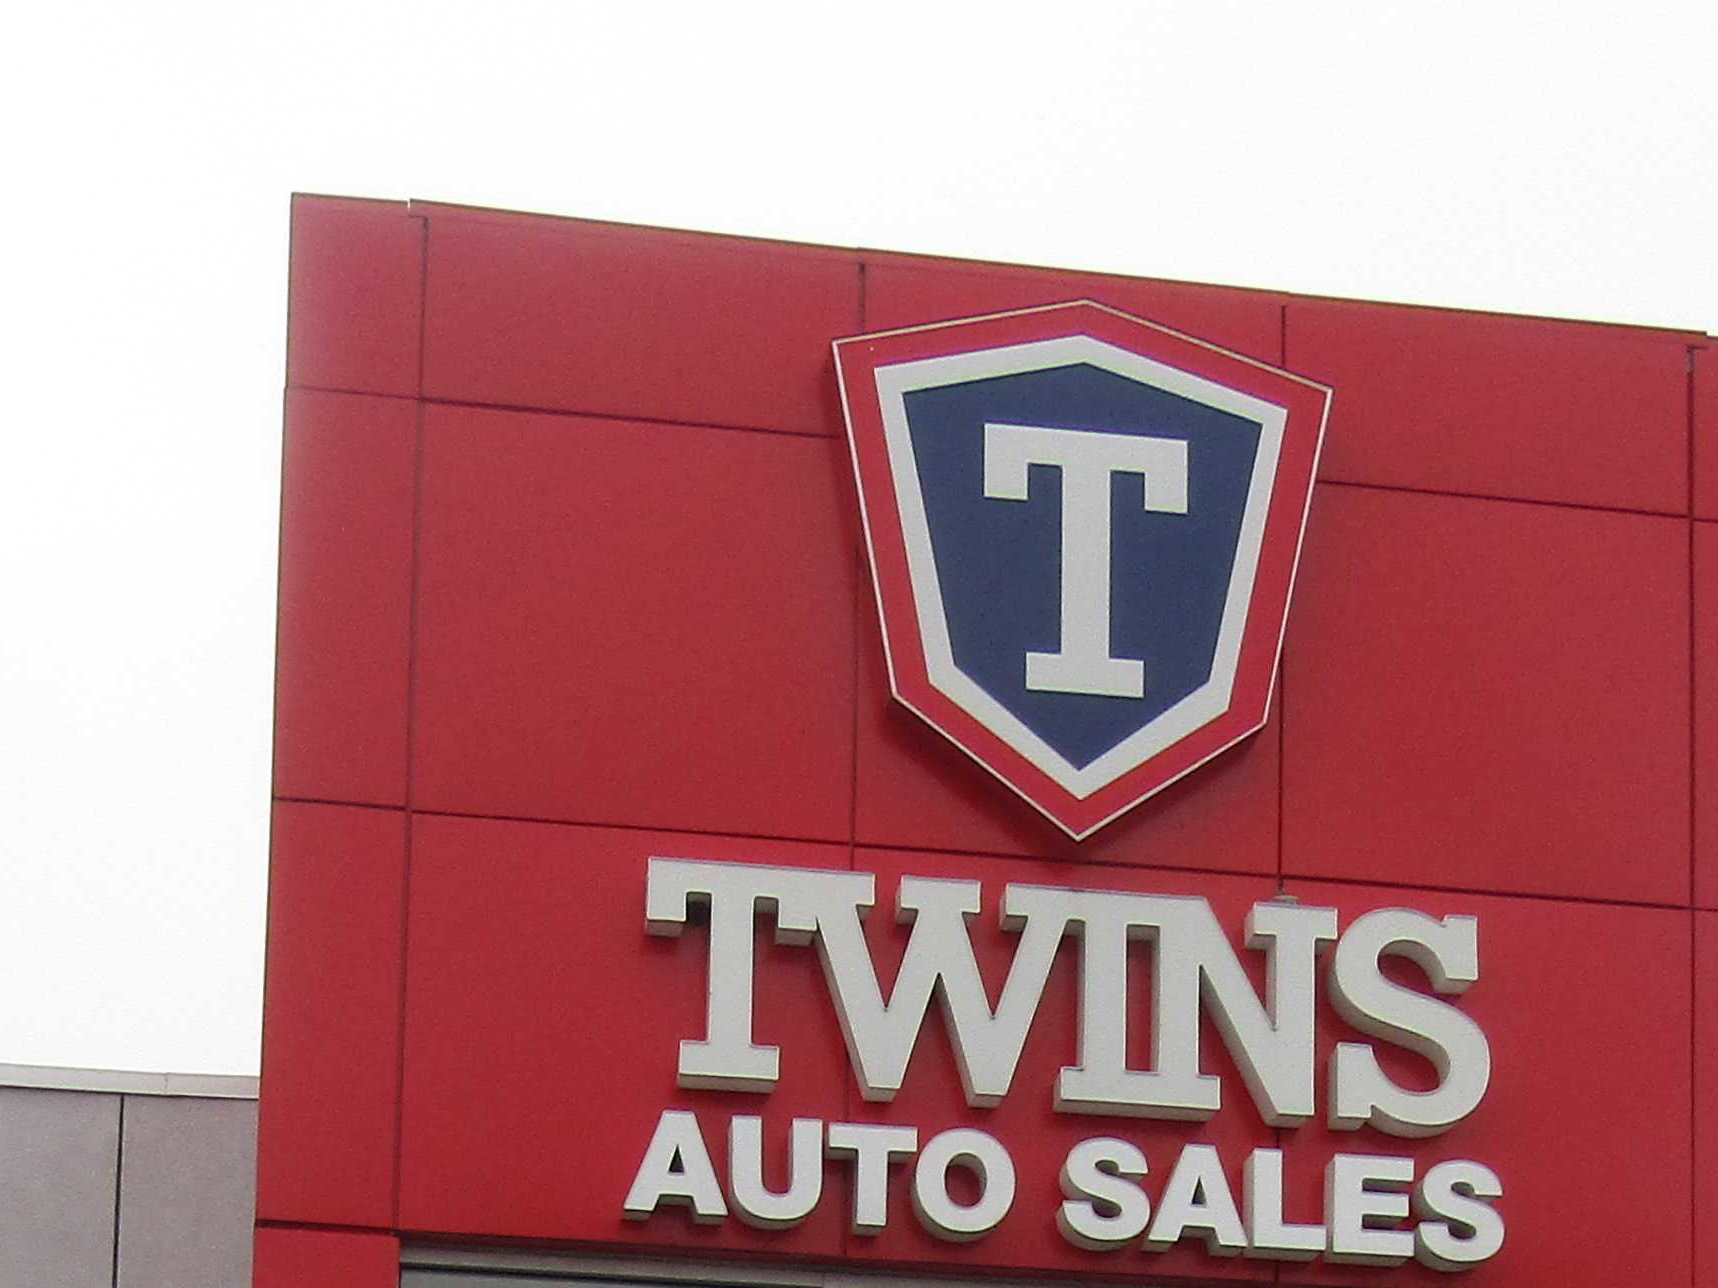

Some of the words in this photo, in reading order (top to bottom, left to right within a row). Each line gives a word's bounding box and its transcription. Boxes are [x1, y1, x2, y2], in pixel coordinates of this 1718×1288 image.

[982, 422, 1189, 698] T
[645, 856, 1491, 1138] TWINS
[622, 1109, 1017, 1243] AUTO
[1059, 1137, 1506, 1271] SALES
